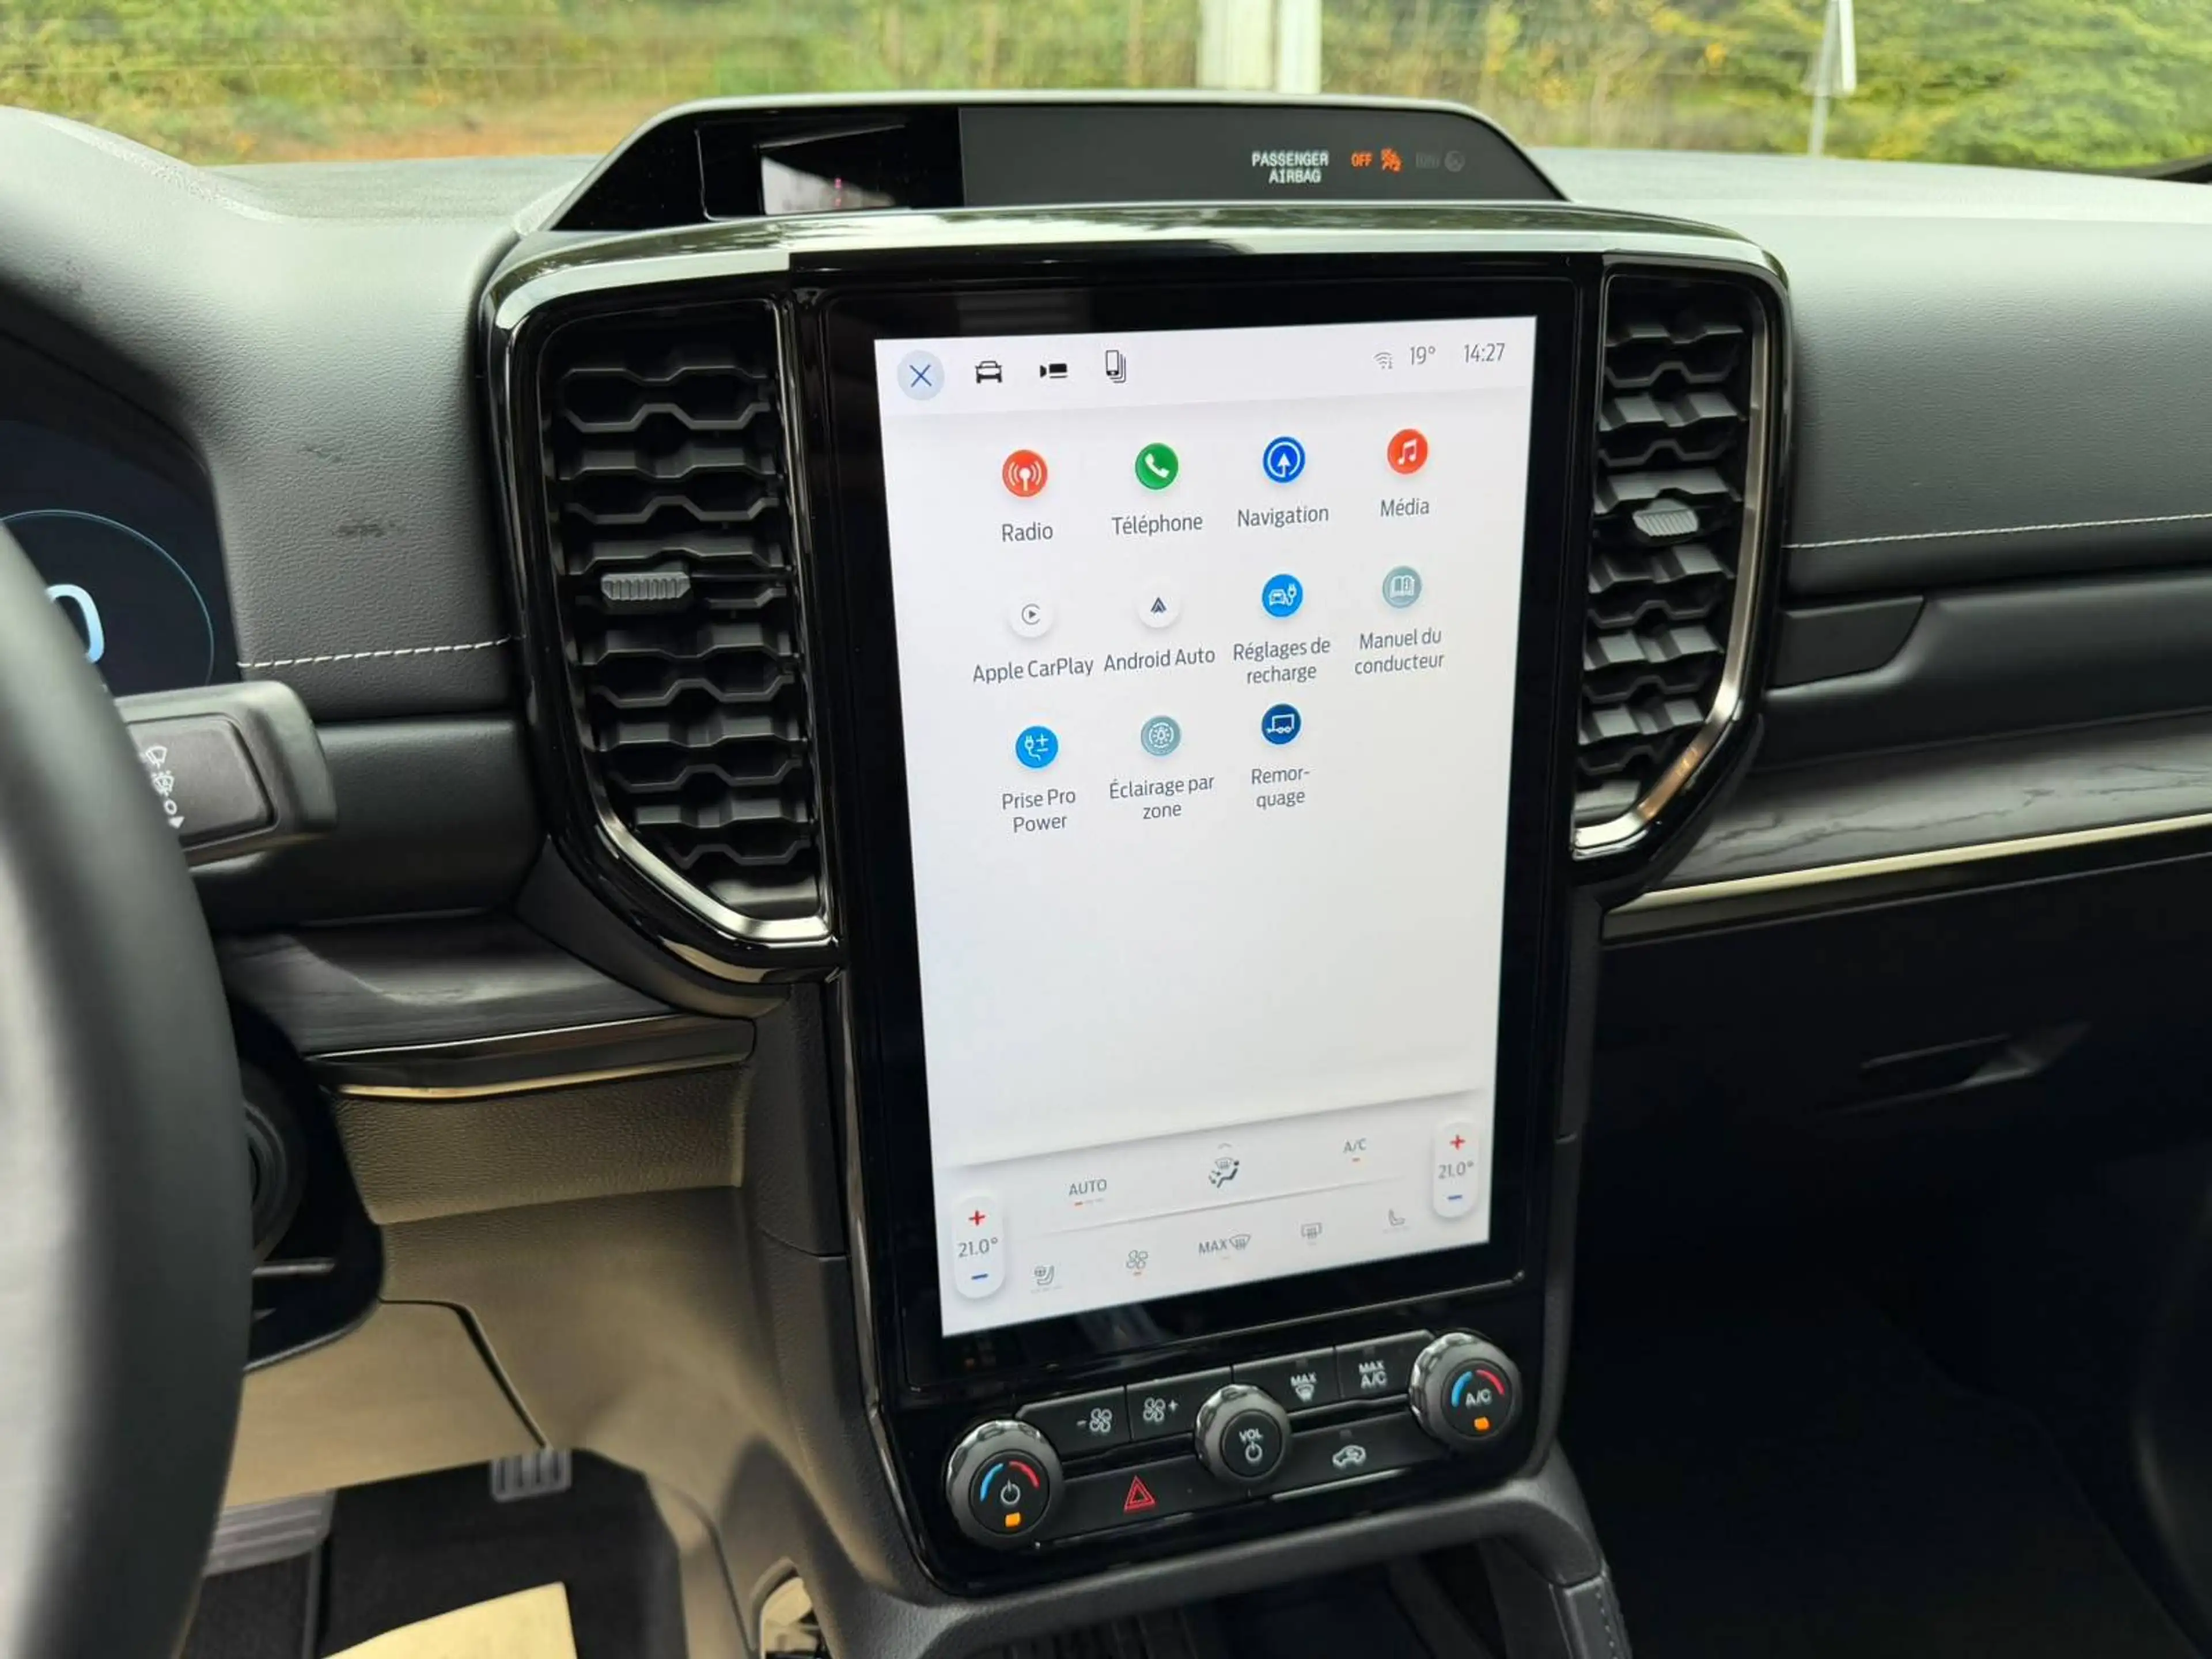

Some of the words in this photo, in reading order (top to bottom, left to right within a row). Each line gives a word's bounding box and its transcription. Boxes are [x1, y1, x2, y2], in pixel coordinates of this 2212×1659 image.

[1252, 151, 1329, 168] PASSENGER
[1351, 152, 1372, 167] OFF
[1268, 168, 1321, 184] AIRBAG
[1410, 346, 1436, 365] 19°
[1464, 342, 1505, 363] 14:27
[1237, 506, 1329, 528] Navigation
[1380, 497, 1430, 518] Média
[1002, 522, 1053, 543] Radio
[1111, 514, 1203, 537] Téléphone
[1359, 629, 1418, 650] Manuel
[1421, 627, 1442, 645] du
[1104, 650, 1171, 672] Android
[1175, 647, 1215, 666] Auto
[1233, 641, 1308, 663] Réglages
[1310, 637, 1331, 654] de
[973, 661, 1024, 684] Apple
[1027, 656, 1094, 679] CarPlay
[1354, 653, 1445, 675] conducteur
[1247, 664, 1317, 685] recharge
[1251, 768, 1310, 785] Remor-
[1109, 778, 1184, 800] Éclairage
[1188, 776, 1214, 795] par
[1002, 793, 1044, 810] Prise
[1047, 789, 1076, 806] Pro
[1256, 791, 1305, 810] quage
[1143, 804, 1182, 820] zone
[1013, 815, 1067, 834] Power
[1343, 1138, 1366, 1154] A/C
[1069, 1179, 1107, 1196] AUTO
[1199, 1239, 1227, 1255] MAX
[1358, 1361, 1385, 1374] MAX
[1290, 1373, 1317, 1387] MAX
[1361, 1371, 1387, 1388] A/C
[1465, 1388, 1491, 1406] A/C
[1239, 1428, 1263, 1444] VOL
